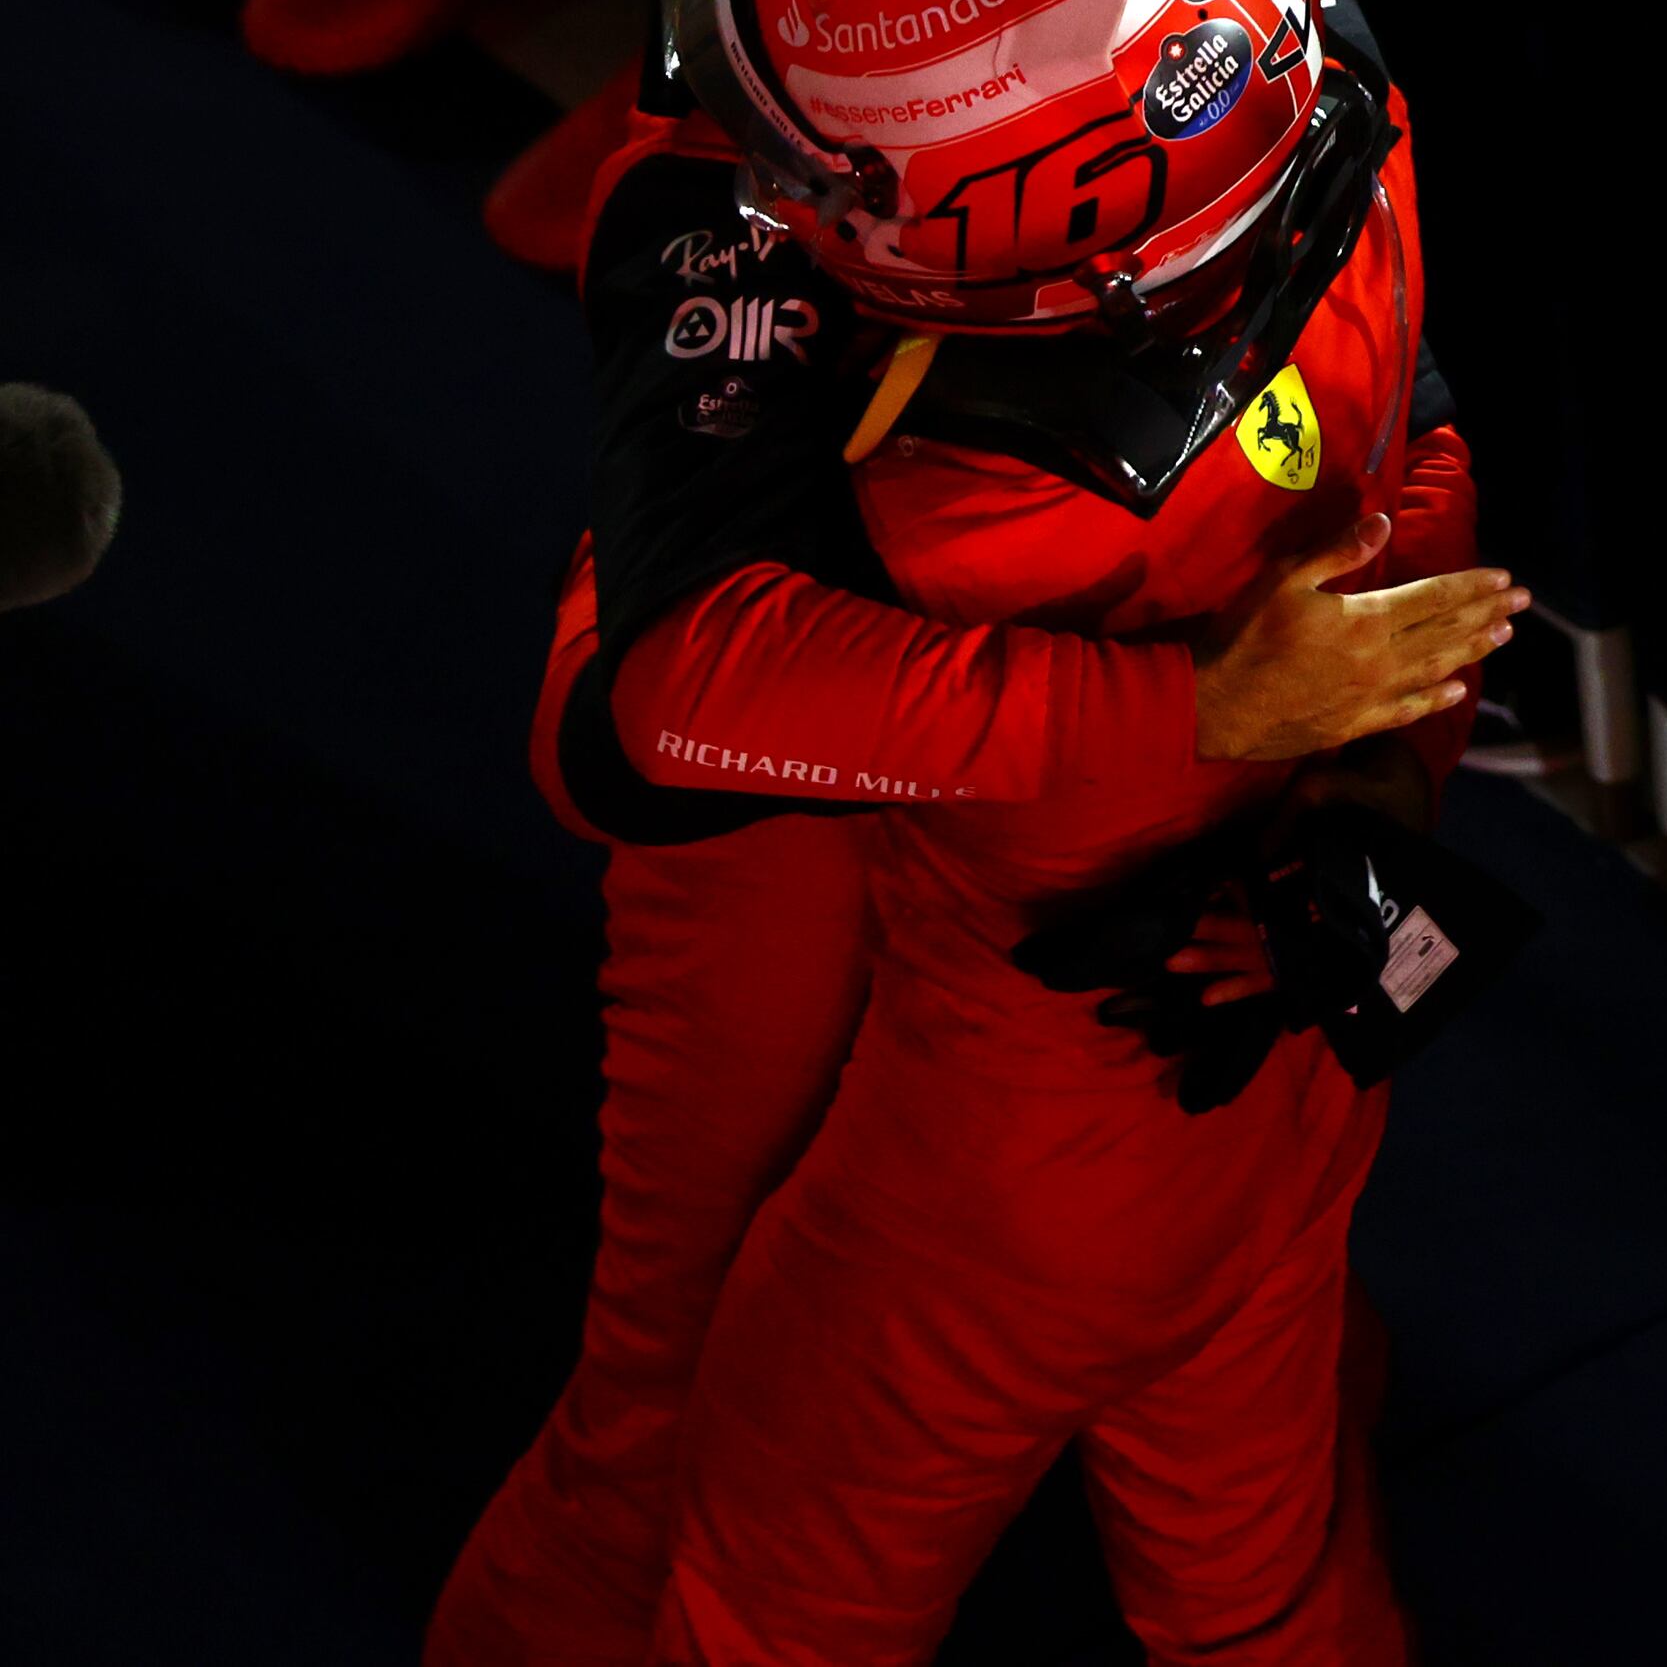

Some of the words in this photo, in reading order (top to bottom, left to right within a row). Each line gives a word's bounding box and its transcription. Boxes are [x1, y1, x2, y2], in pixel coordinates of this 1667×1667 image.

[809, 63, 1027, 125] #essereFerrari
[1155, 32, 1229, 111] Estrella
[1170, 52, 1239, 124] Galicia
[925, 112, 1168, 288] 16
[656, 728, 839, 786] RICHARD
